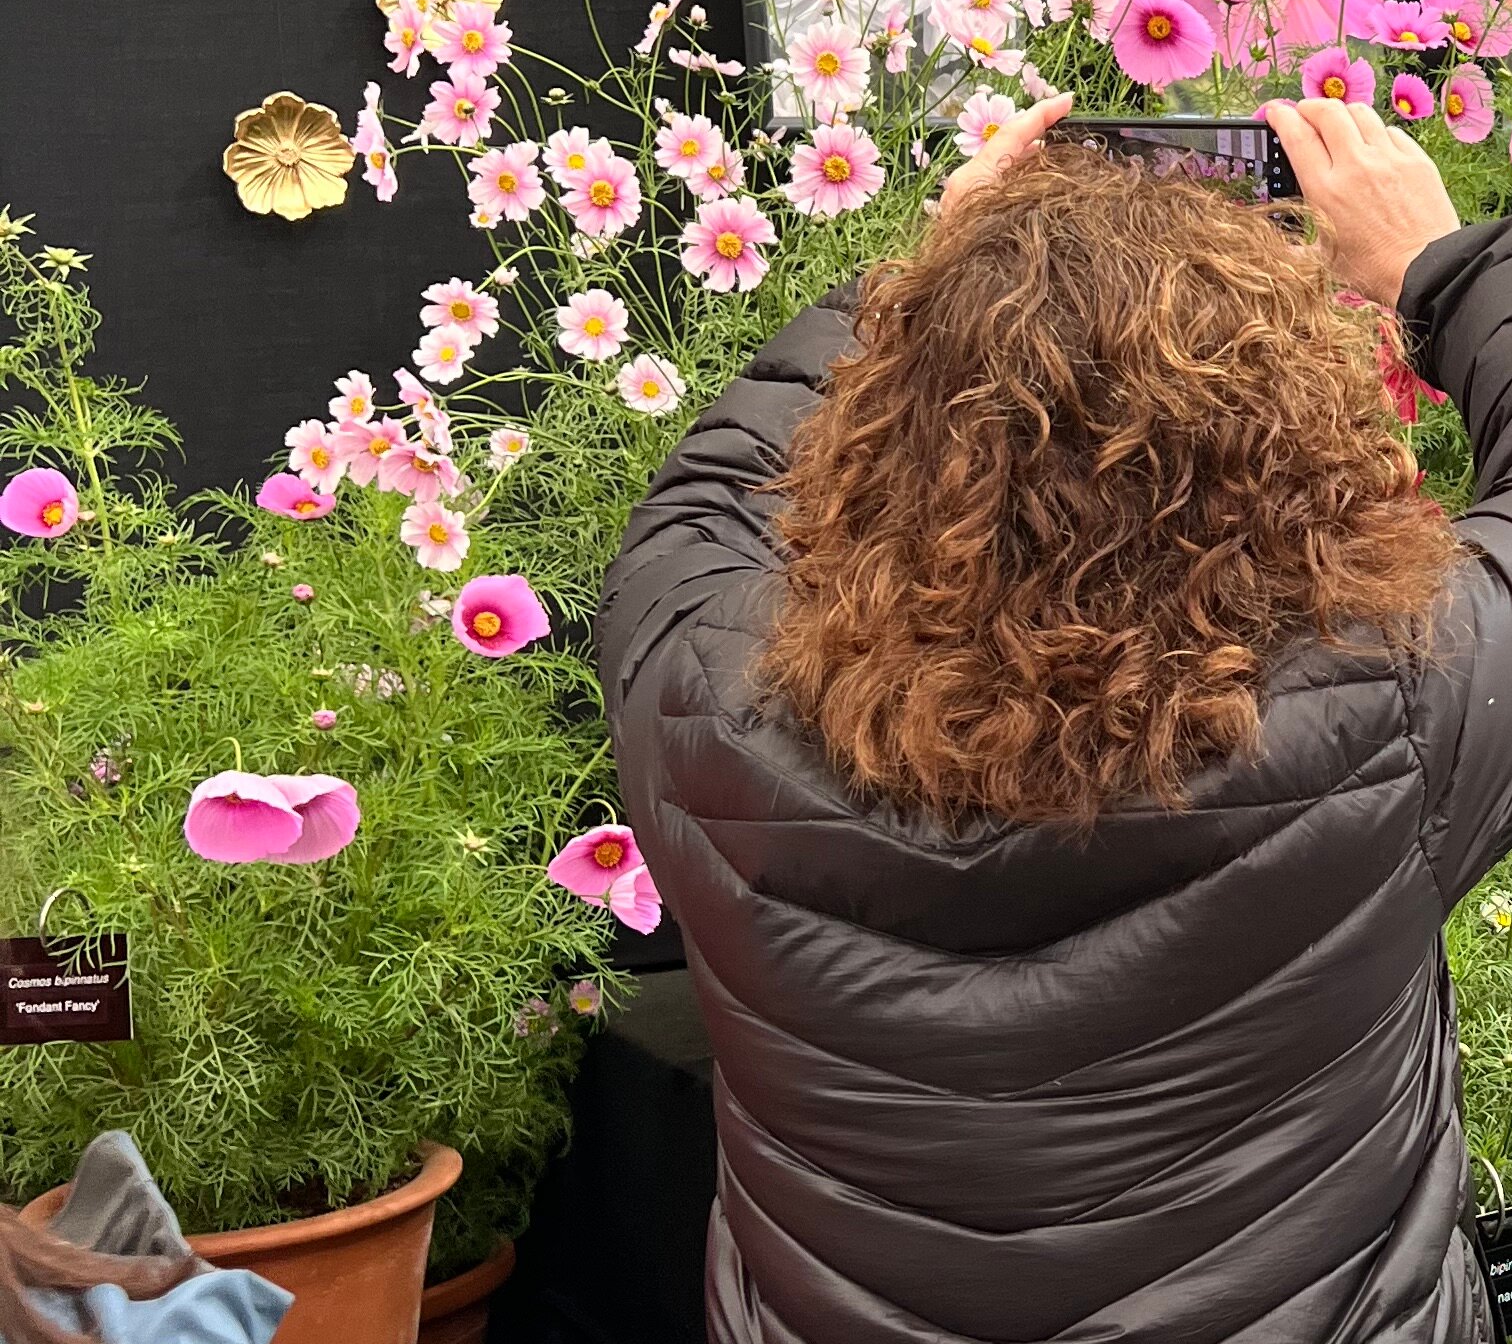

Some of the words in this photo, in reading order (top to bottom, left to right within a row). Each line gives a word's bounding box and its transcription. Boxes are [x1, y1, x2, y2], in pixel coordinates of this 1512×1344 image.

[8, 977, 52, 989] Cosmos
[15, 1000, 63, 1014] 'Fondant
[64, 998, 101, 1013] Fancy'
